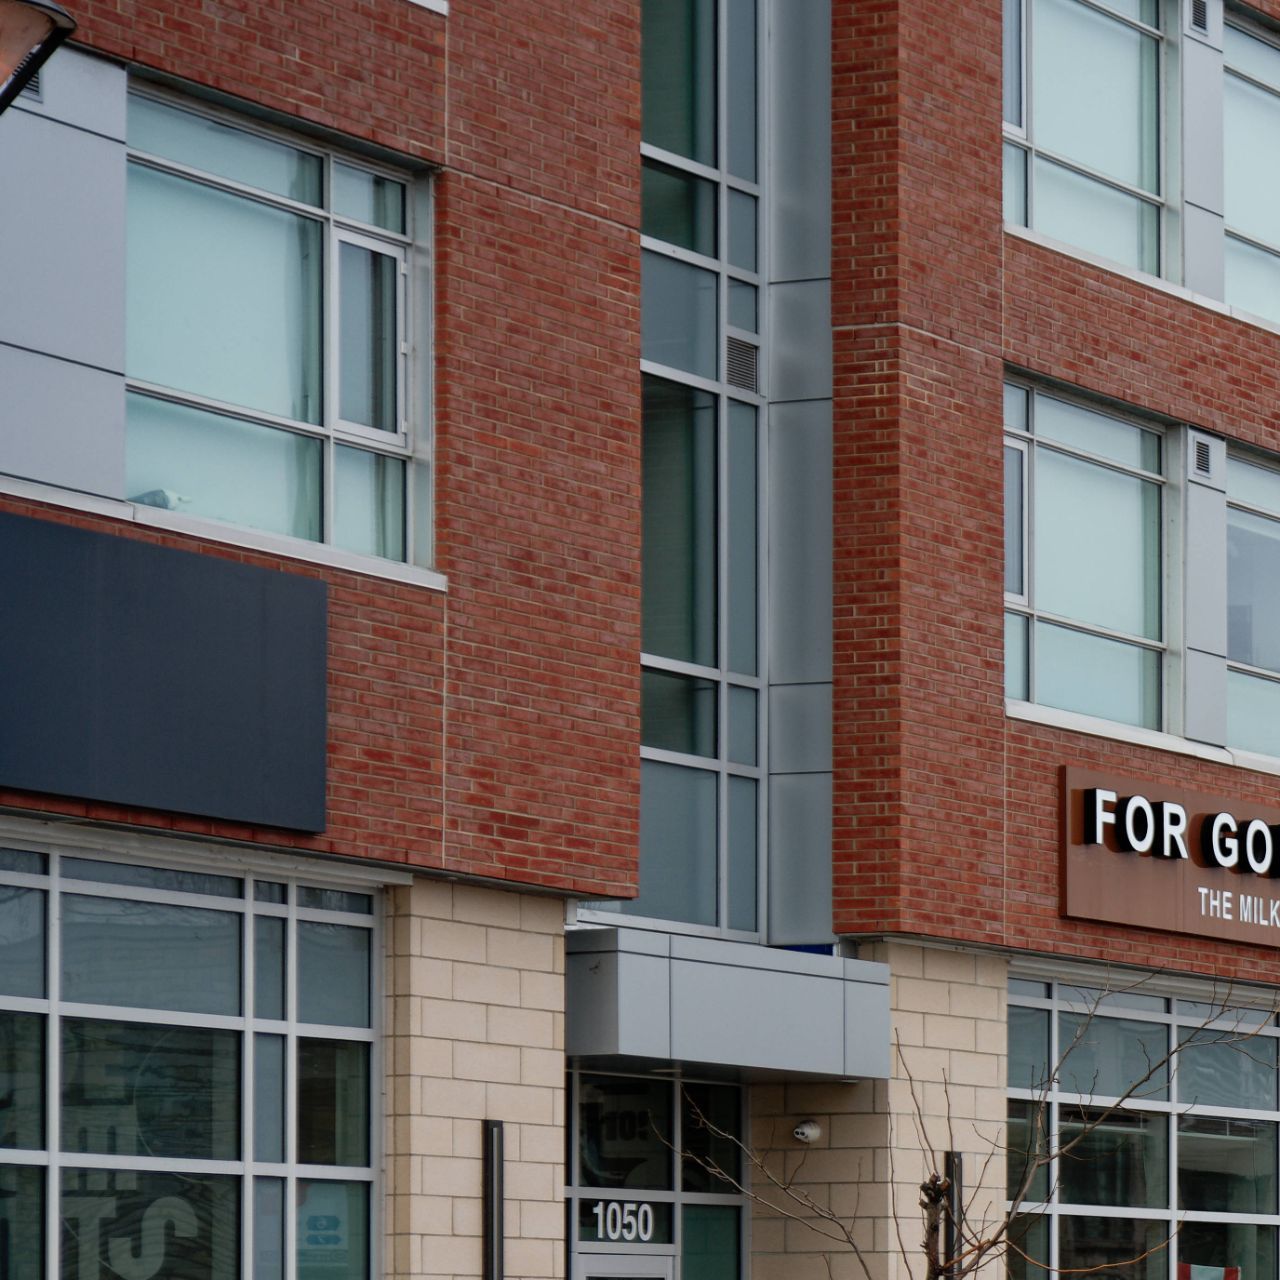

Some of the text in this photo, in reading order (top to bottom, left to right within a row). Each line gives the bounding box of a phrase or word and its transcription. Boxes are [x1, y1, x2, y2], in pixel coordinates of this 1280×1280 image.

[1095, 788, 1188, 859] FOR
[1198, 887, 1233, 920] THE
[592, 1201, 653, 1241] 1050
